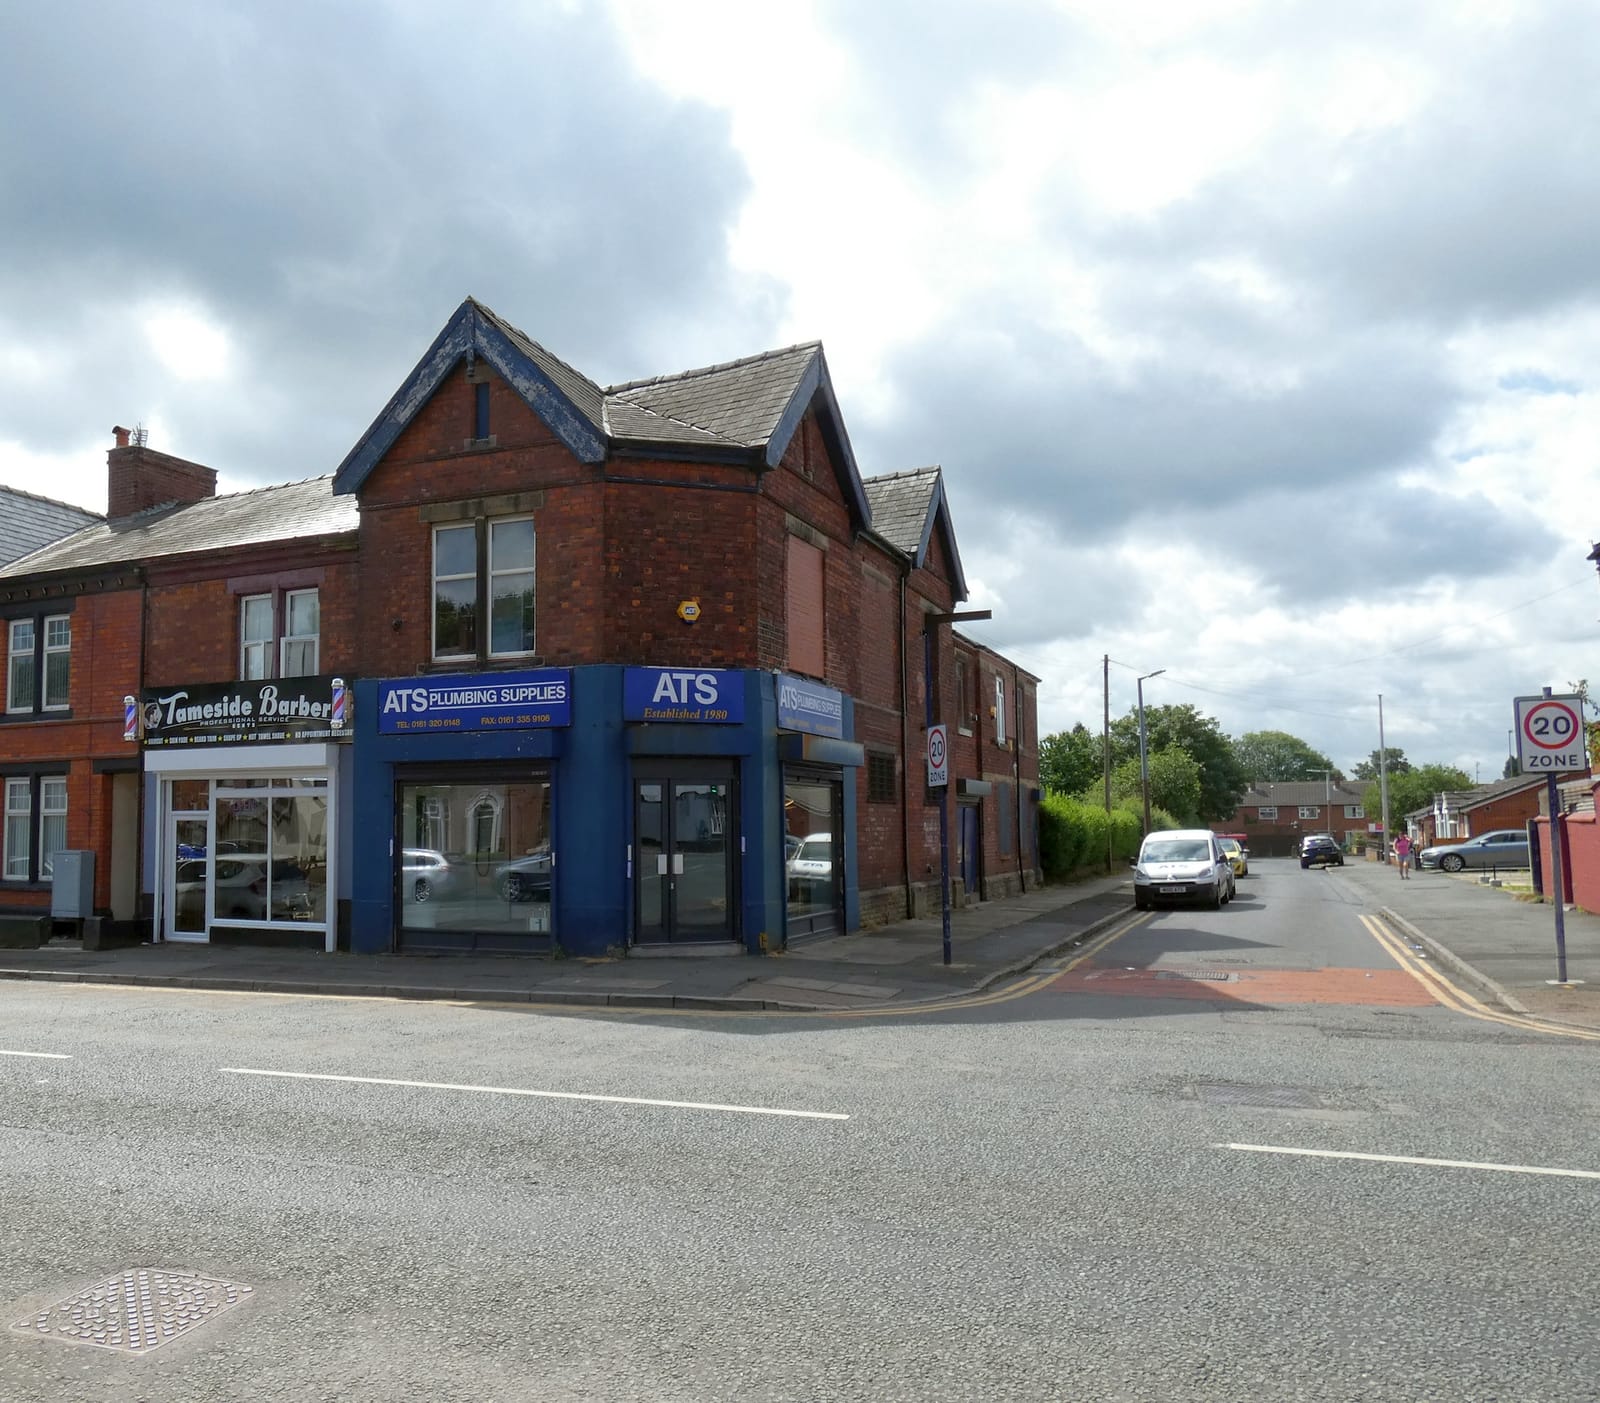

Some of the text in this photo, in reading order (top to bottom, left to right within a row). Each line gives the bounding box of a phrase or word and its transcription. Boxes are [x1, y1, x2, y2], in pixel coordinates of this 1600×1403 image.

[652, 672, 718, 705] ATS
[158, 685, 331, 725] Tameside Barber
[383, 685, 566, 713] ATS PLUMBING SUPPLIES
[780, 685, 841, 717] ATS PLUMBING SUPPLIES
[200, 717, 255, 727] PROFESSIONAL
[498, 716, 514, 724] 0161
[643, 707, 728, 720] Established 1980
[1533, 716, 1571, 735] 20
[931, 740, 943, 757] 20
[1529, 754, 1578, 767] ZONE
[930, 770, 945, 782] ZONE
